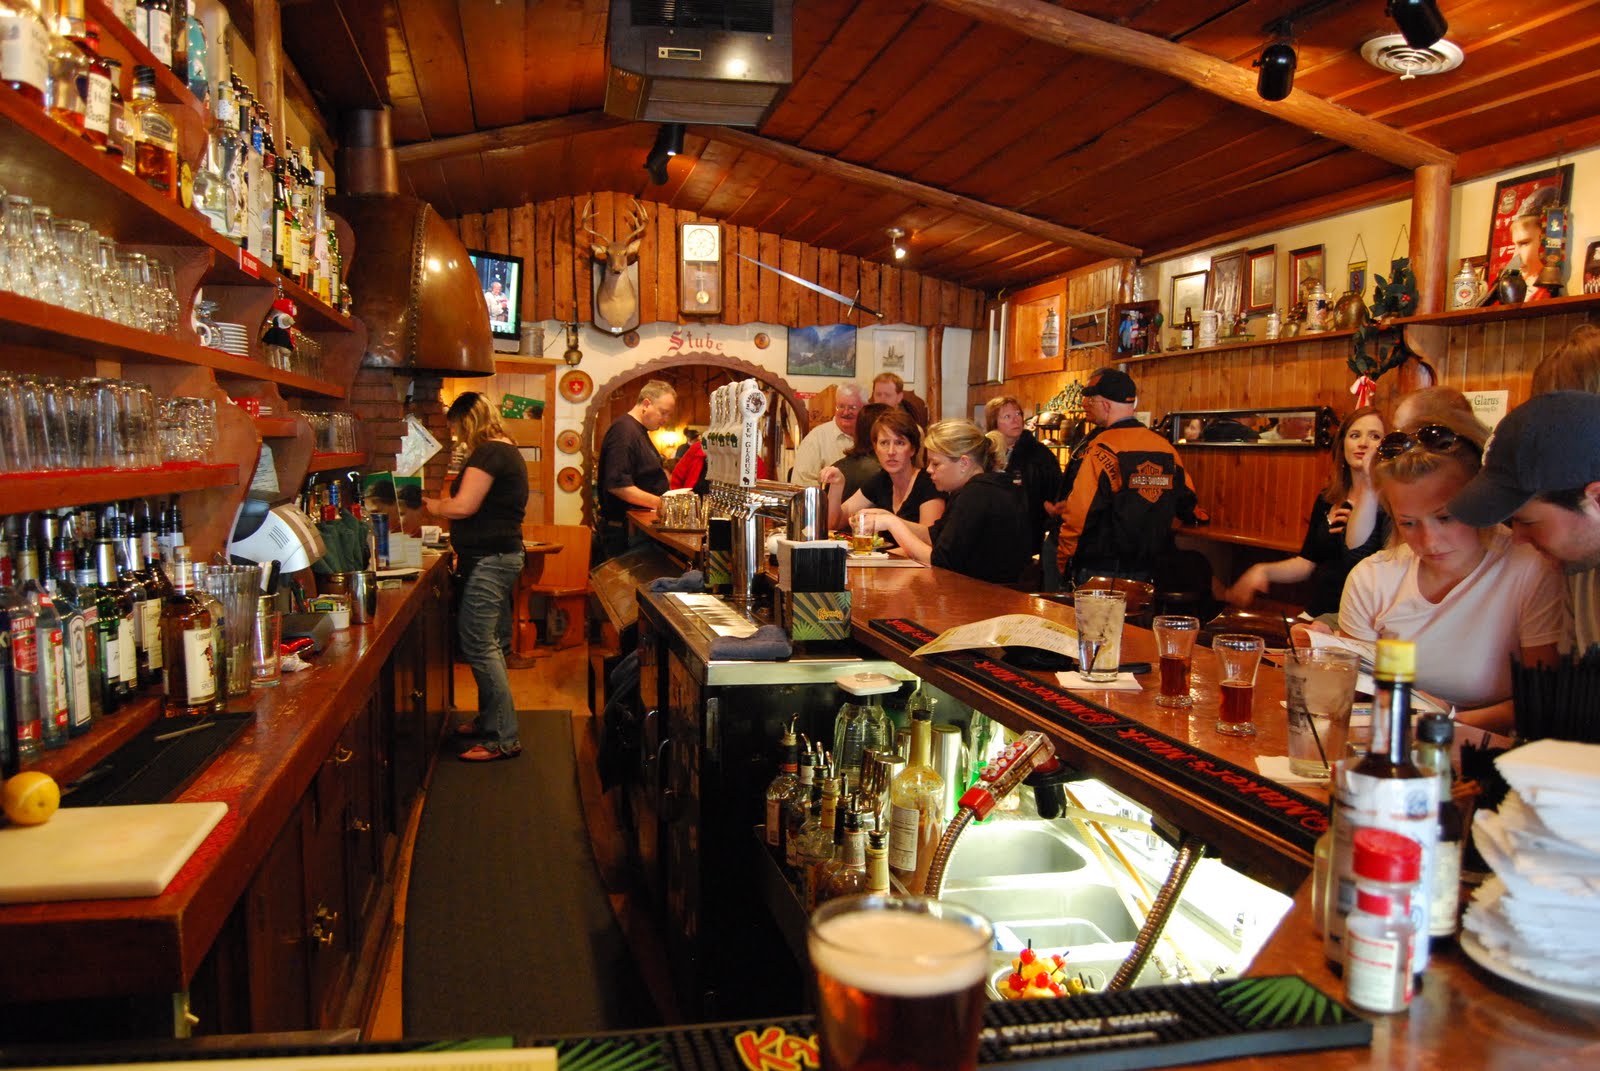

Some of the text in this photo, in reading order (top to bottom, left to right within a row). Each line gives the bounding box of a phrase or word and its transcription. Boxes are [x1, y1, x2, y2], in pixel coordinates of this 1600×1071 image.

[668, 330, 724, 352] Stube
[1474, 395, 1500, 406] Glarus
[975, 660, 1100, 717] Maker's Mark
[1115, 727, 1199, 761] Mark
[1187, 758, 1325, 818] Maker's
